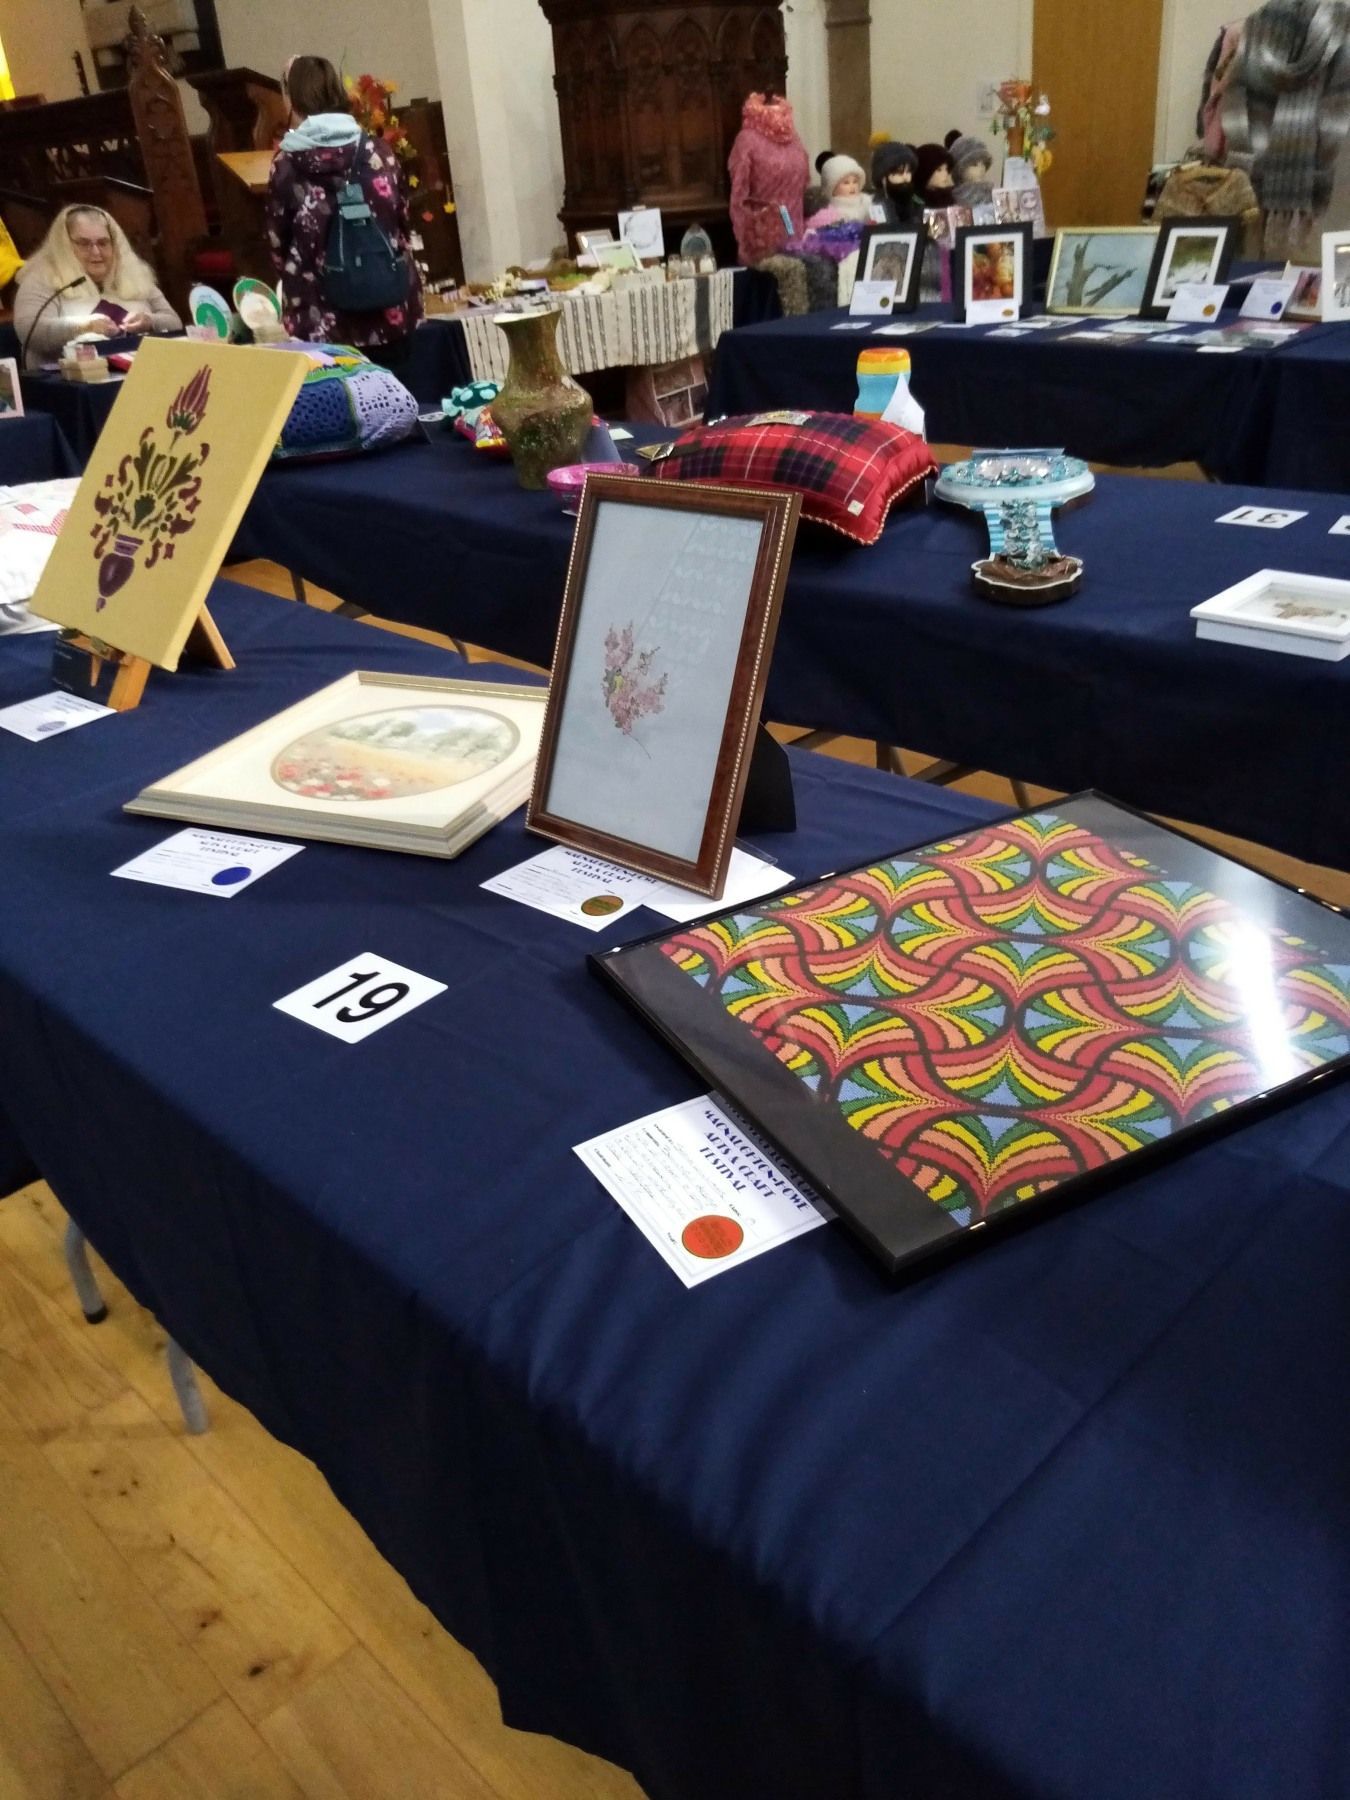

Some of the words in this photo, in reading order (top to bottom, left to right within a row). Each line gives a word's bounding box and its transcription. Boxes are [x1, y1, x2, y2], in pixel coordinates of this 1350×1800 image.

[312, 971, 410, 1023] 19
[699, 1146, 747, 1192] FESTIVAL
[704, 1132, 732, 1158] ARTS
[738, 1164, 777, 1198] CRAFT
